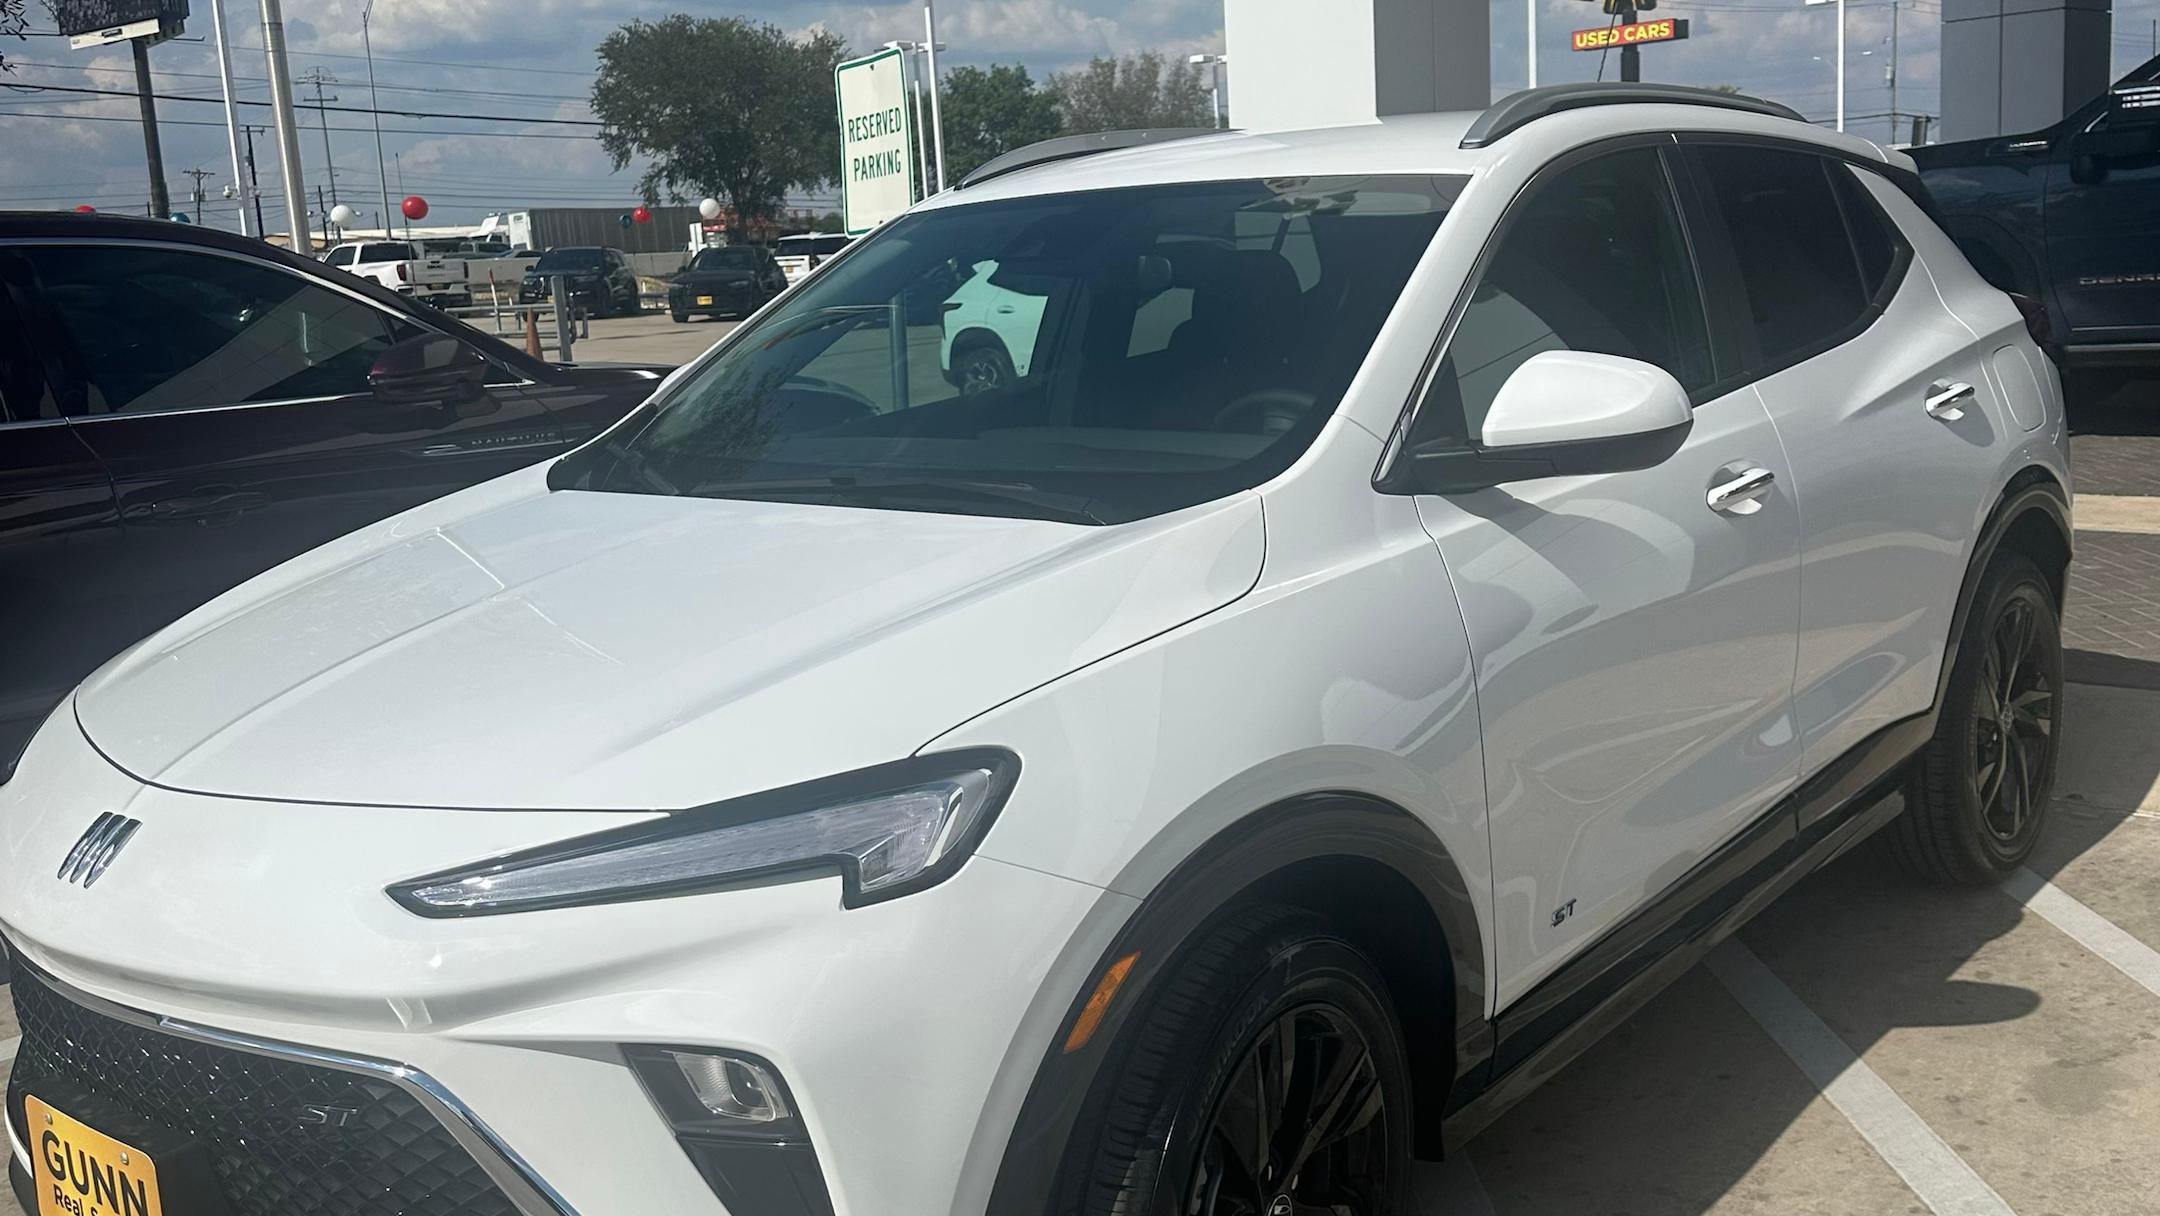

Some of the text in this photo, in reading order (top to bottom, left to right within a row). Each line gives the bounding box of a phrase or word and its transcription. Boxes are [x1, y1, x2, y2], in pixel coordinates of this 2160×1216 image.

[1576, 22, 1670, 48] USED CARS
[848, 107, 902, 143] RESERVED
[854, 149, 902, 182] PARKING
[1551, 898, 1577, 928] ST
[299, 1103, 358, 1126] ST
[42, 1130, 149, 1216] GUNN
